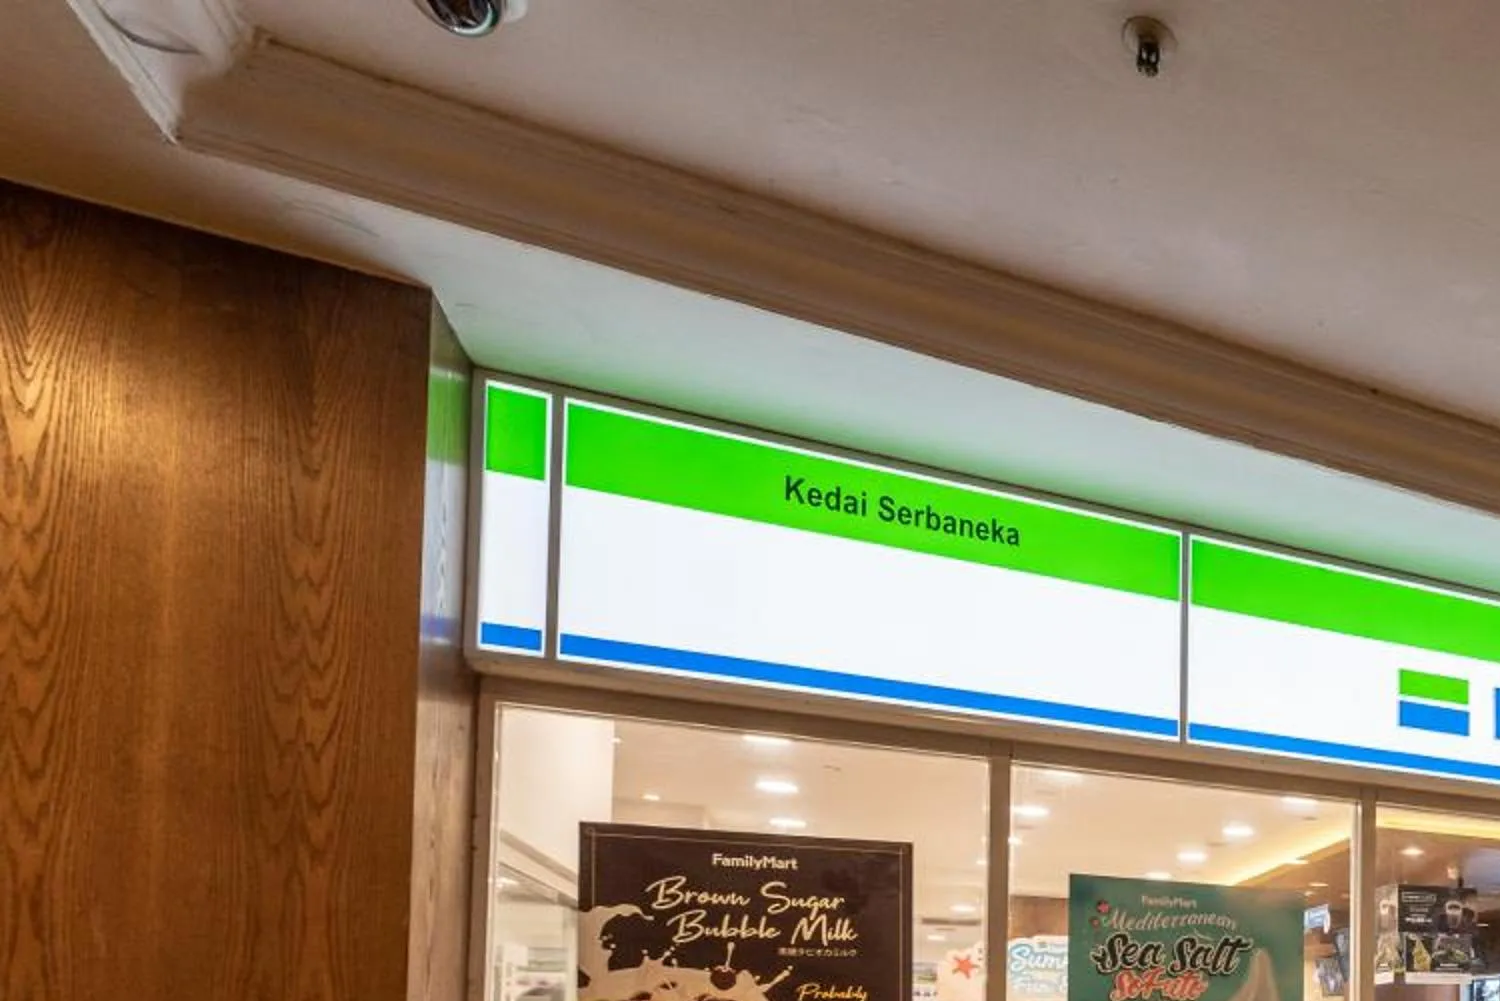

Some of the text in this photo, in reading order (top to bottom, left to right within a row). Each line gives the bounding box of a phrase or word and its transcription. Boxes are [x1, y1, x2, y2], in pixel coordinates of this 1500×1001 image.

[784, 475, 1020, 546] Kedai Serbaneka
[712, 853, 798, 870] FamilyMart
[645, 875, 845, 921] Brown Sugar
[666, 909, 858, 946] Bubble Milk
[1104, 908, 1237, 933] Mediterranean
[1091, 932, 1253, 975] Sea Salt
